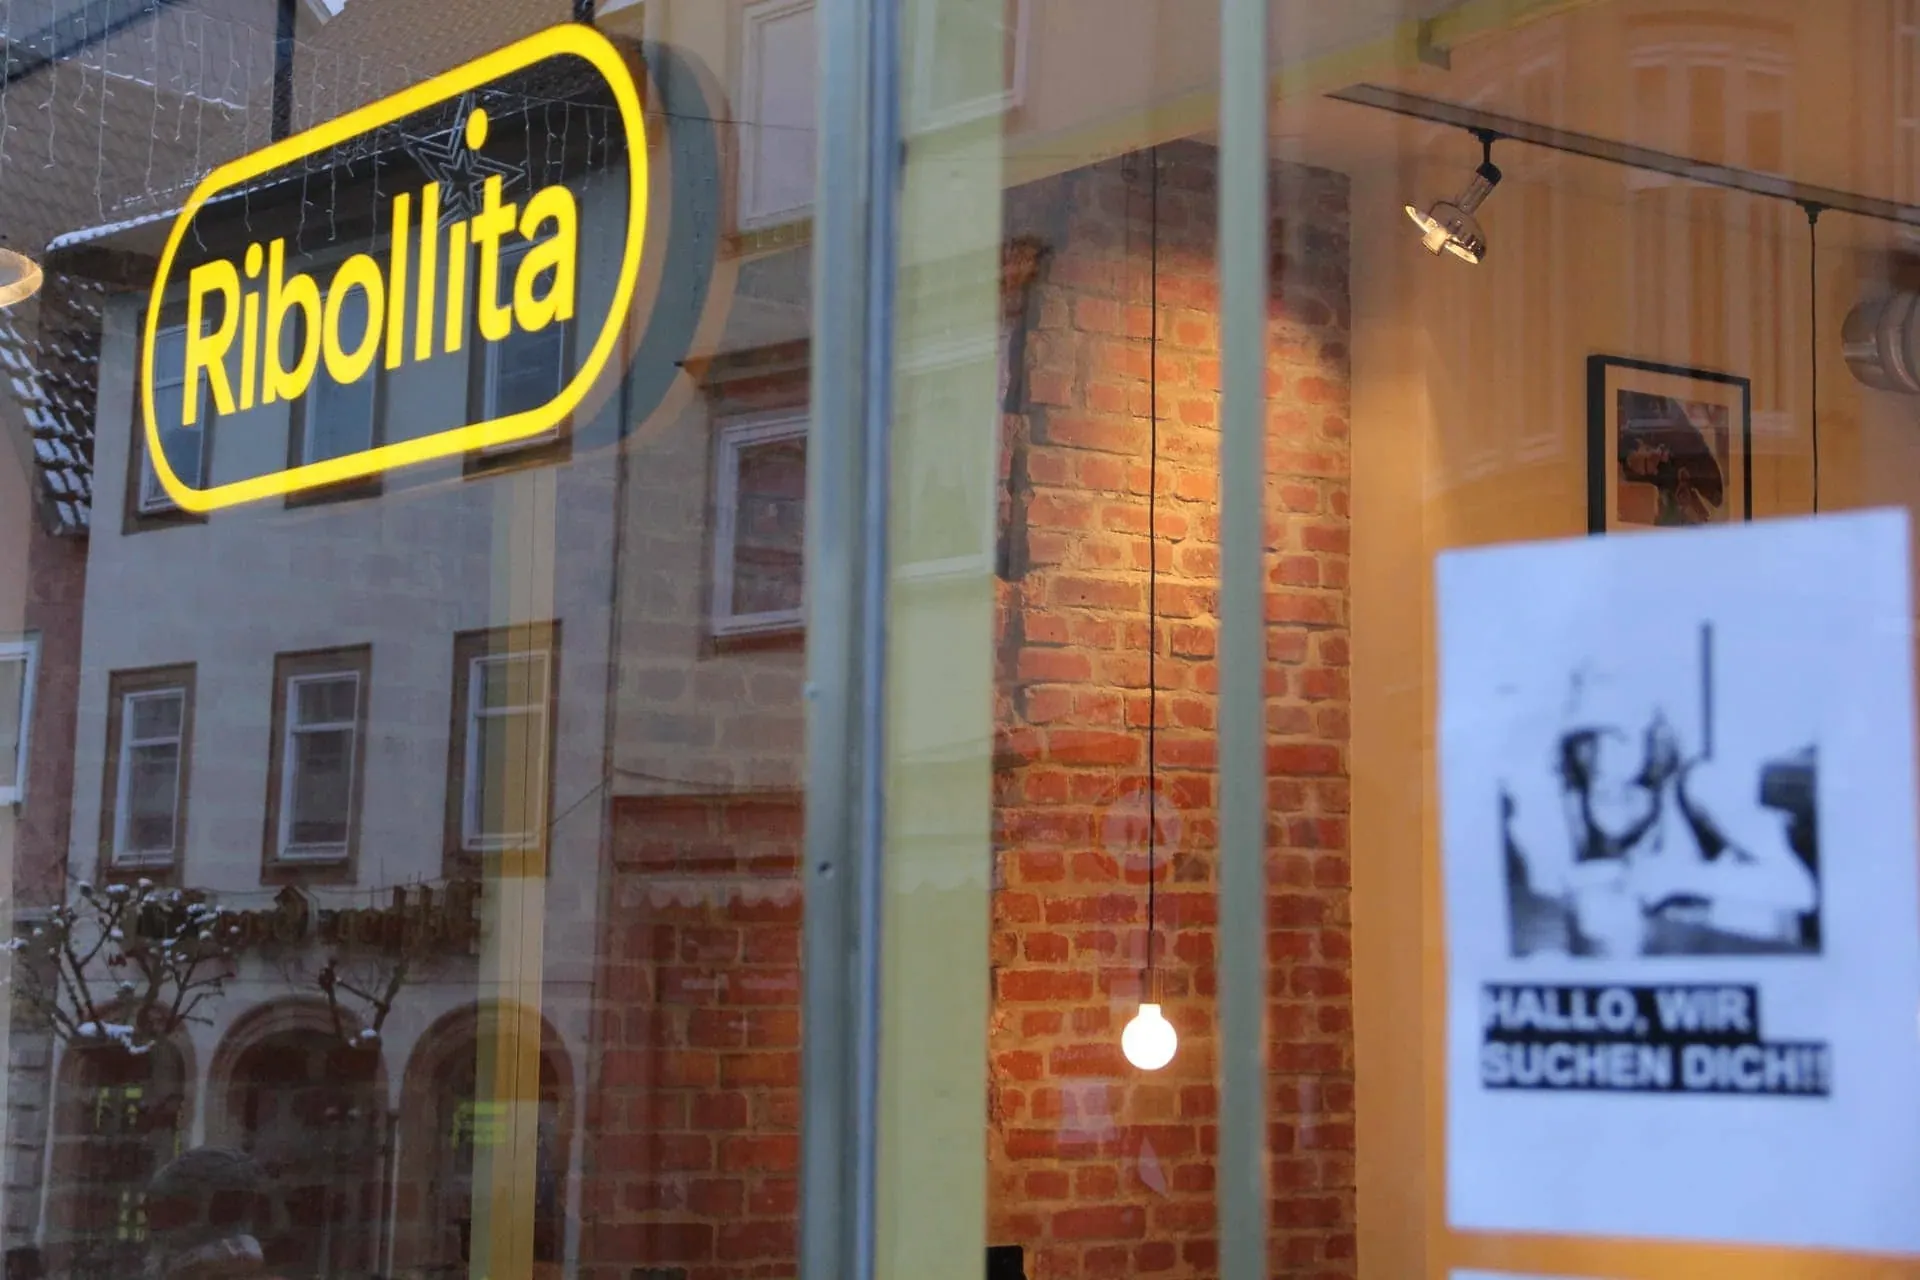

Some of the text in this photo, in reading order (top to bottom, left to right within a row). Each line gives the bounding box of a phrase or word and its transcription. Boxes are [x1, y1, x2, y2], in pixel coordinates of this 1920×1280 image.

[182, 107, 578, 426] Ribollita
[1654, 987, 1752, 1033] WIR
[1483, 1041, 1672, 1087] SUCHEN
